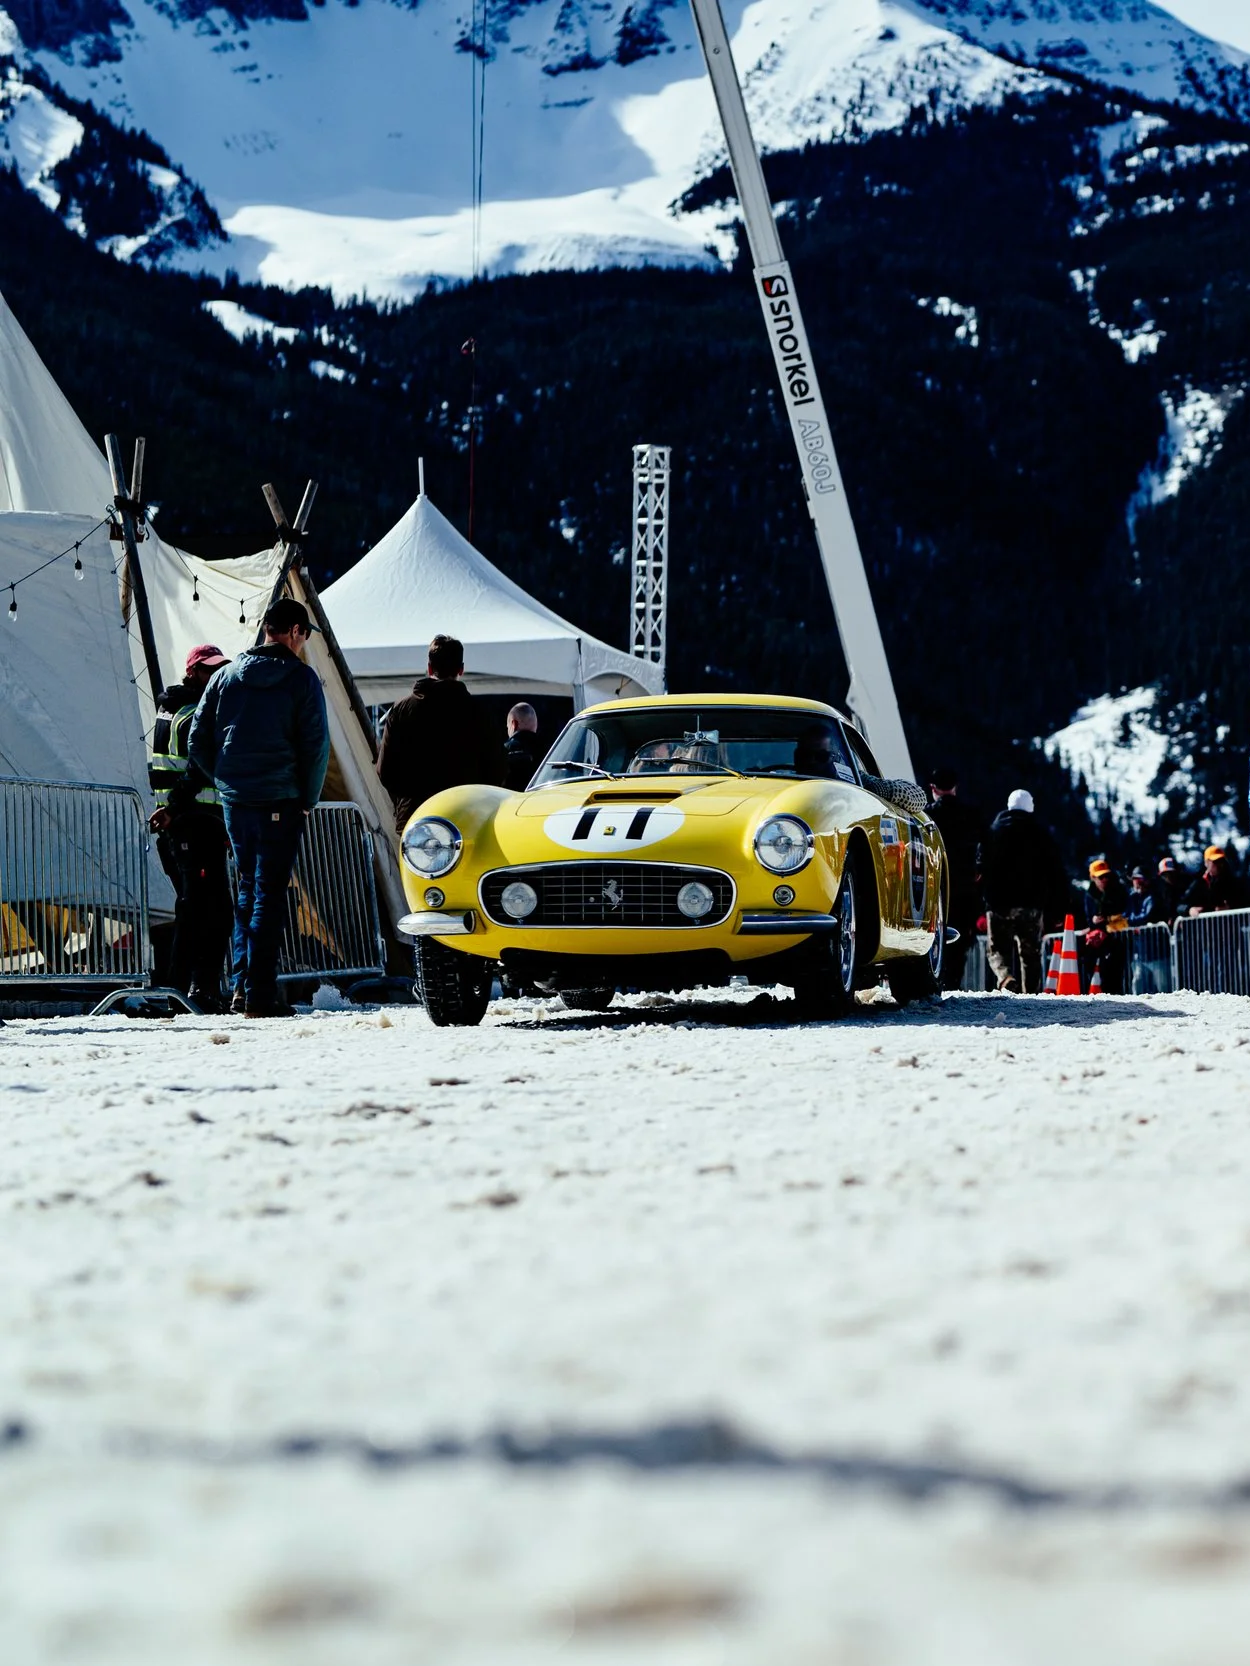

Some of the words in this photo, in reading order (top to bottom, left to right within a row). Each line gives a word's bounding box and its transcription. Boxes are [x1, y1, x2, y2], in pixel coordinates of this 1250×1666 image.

[770, 300, 815, 406] snorkel
[798, 419, 836, 495] AB60J
[572, 807, 656, 840] 11
